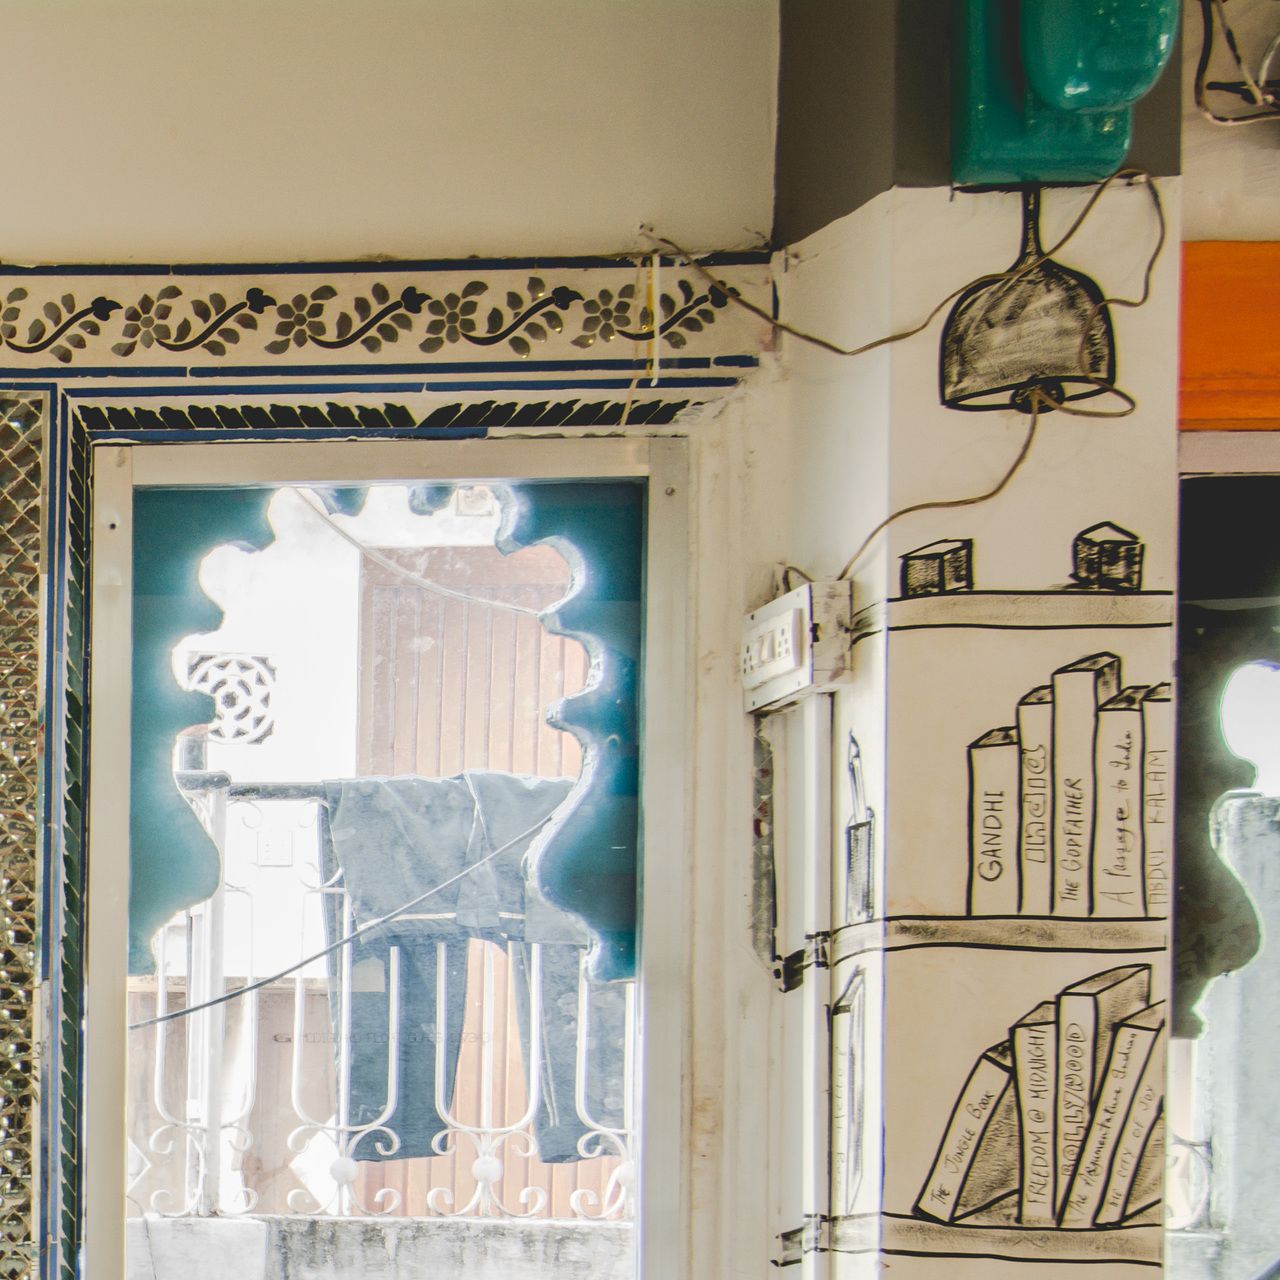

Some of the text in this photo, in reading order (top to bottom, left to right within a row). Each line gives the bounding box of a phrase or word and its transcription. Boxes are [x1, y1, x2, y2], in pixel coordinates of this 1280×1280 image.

[1147, 750, 1168, 824] KALAM
[977, 790, 1005, 882] GANDHI
[1100, 891, 1135, 905] A
[1027, 1132, 1050, 1203] FREEDOM
